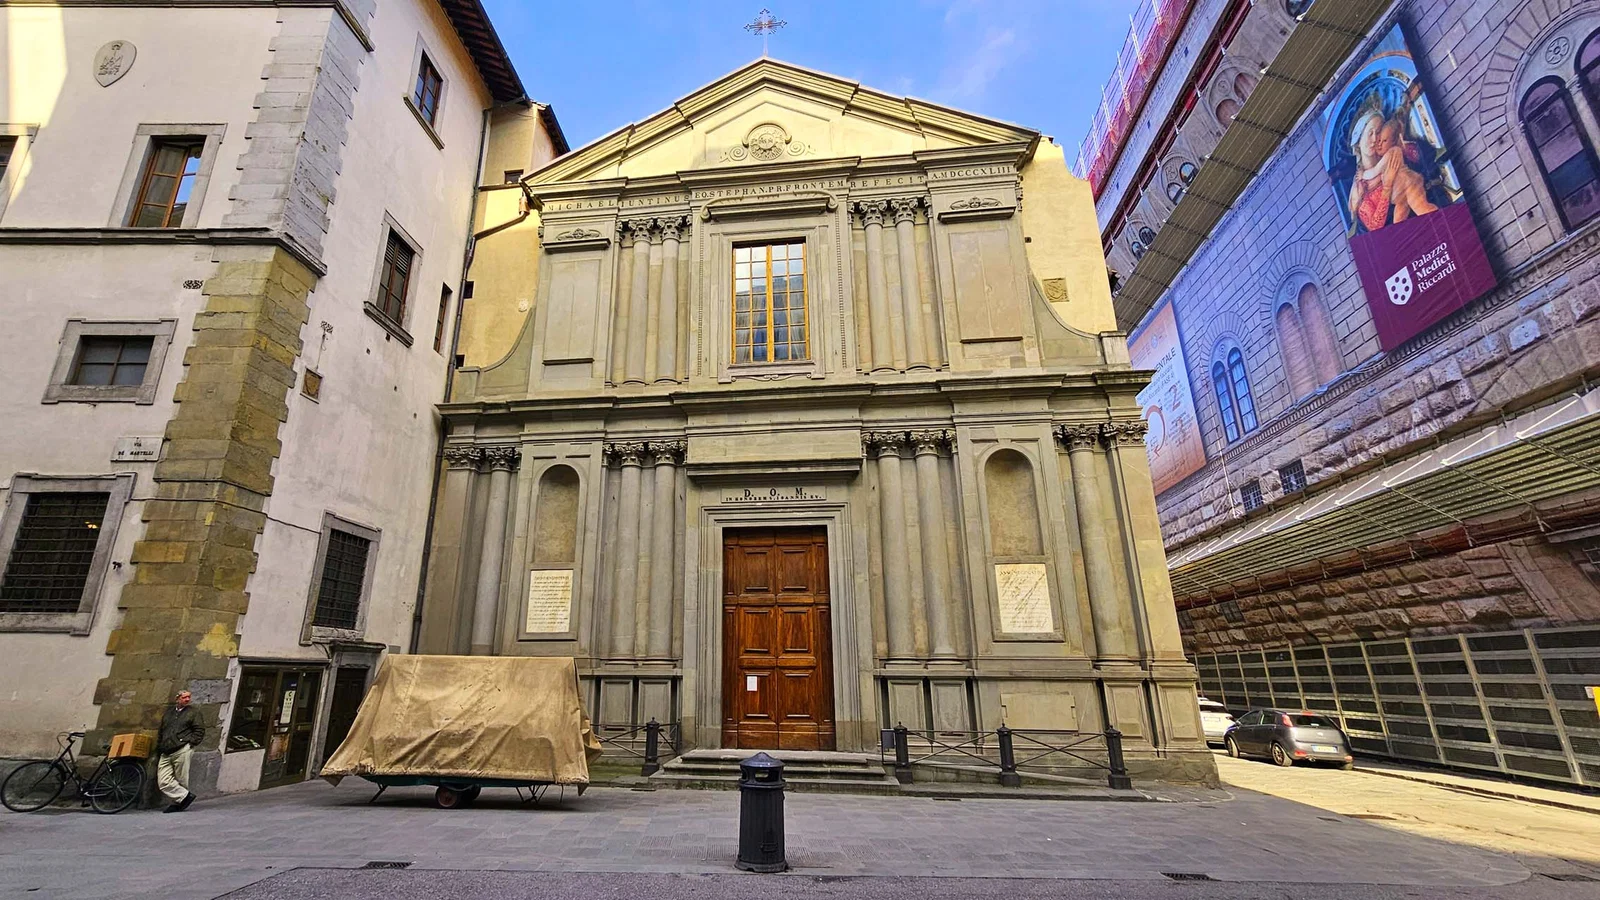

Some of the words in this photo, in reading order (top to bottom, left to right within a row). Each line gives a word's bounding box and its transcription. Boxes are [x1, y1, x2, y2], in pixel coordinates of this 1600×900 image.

[548, 200, 615, 211] MICHAEL
[850, 175, 925, 188] REFECIT
[1411, 242, 1447, 272] Palazzo
[1416, 251, 1451, 281] Medici
[1417, 260, 1457, 293] Riccardi
[1155, 347, 1177, 373] ENTALE
